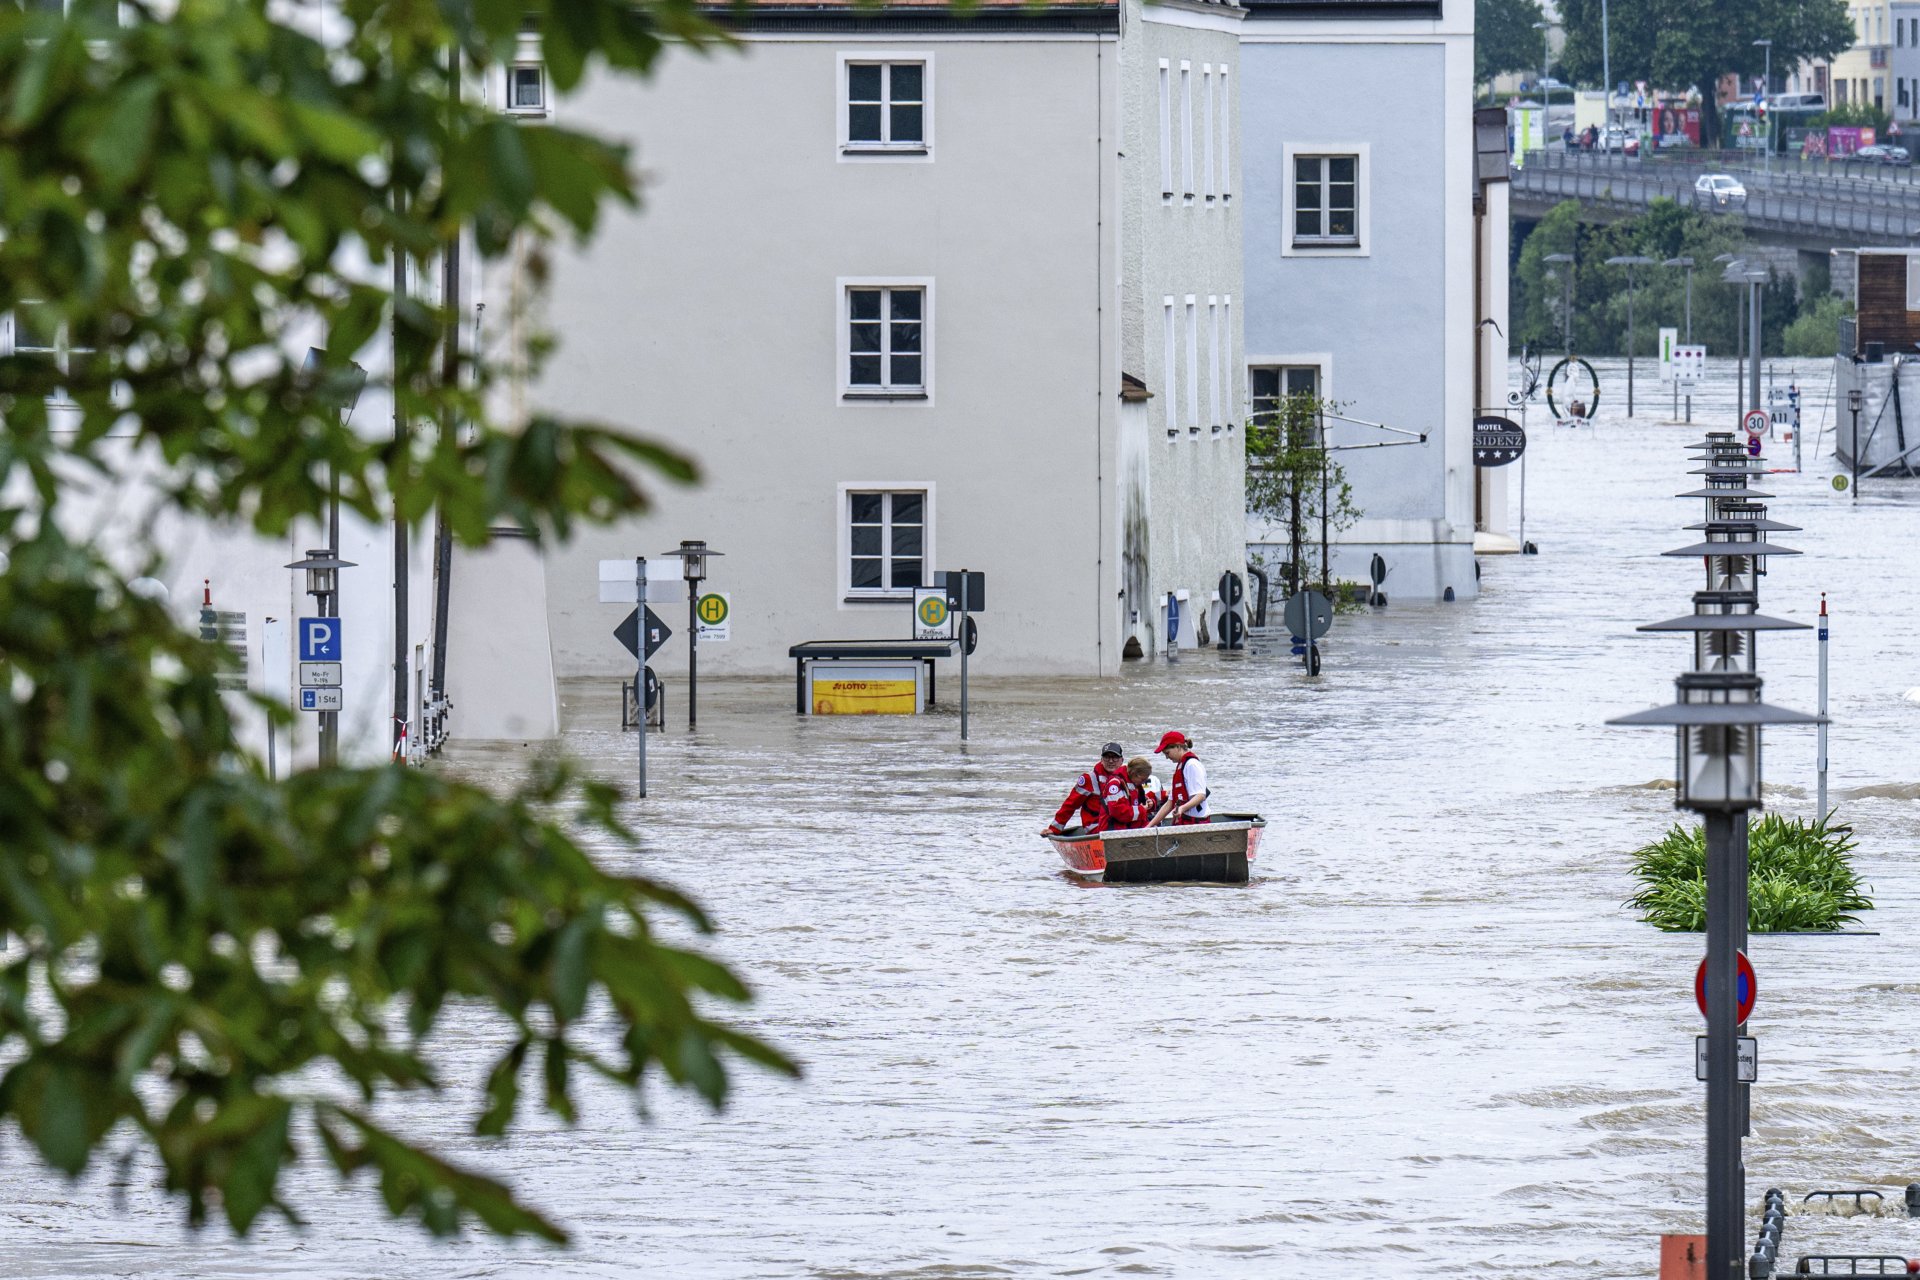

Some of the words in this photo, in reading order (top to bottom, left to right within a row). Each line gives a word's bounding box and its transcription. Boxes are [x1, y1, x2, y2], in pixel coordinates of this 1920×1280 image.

[1749, 417, 1764, 429] 30
[1473, 436, 1522, 446] SIDENZ
[706, 601, 719, 618] H
[927, 604, 940, 620] H
[309, 623, 332, 656] P
[318, 695, 322, 703] 1
[323, 695, 338, 704] Std.
